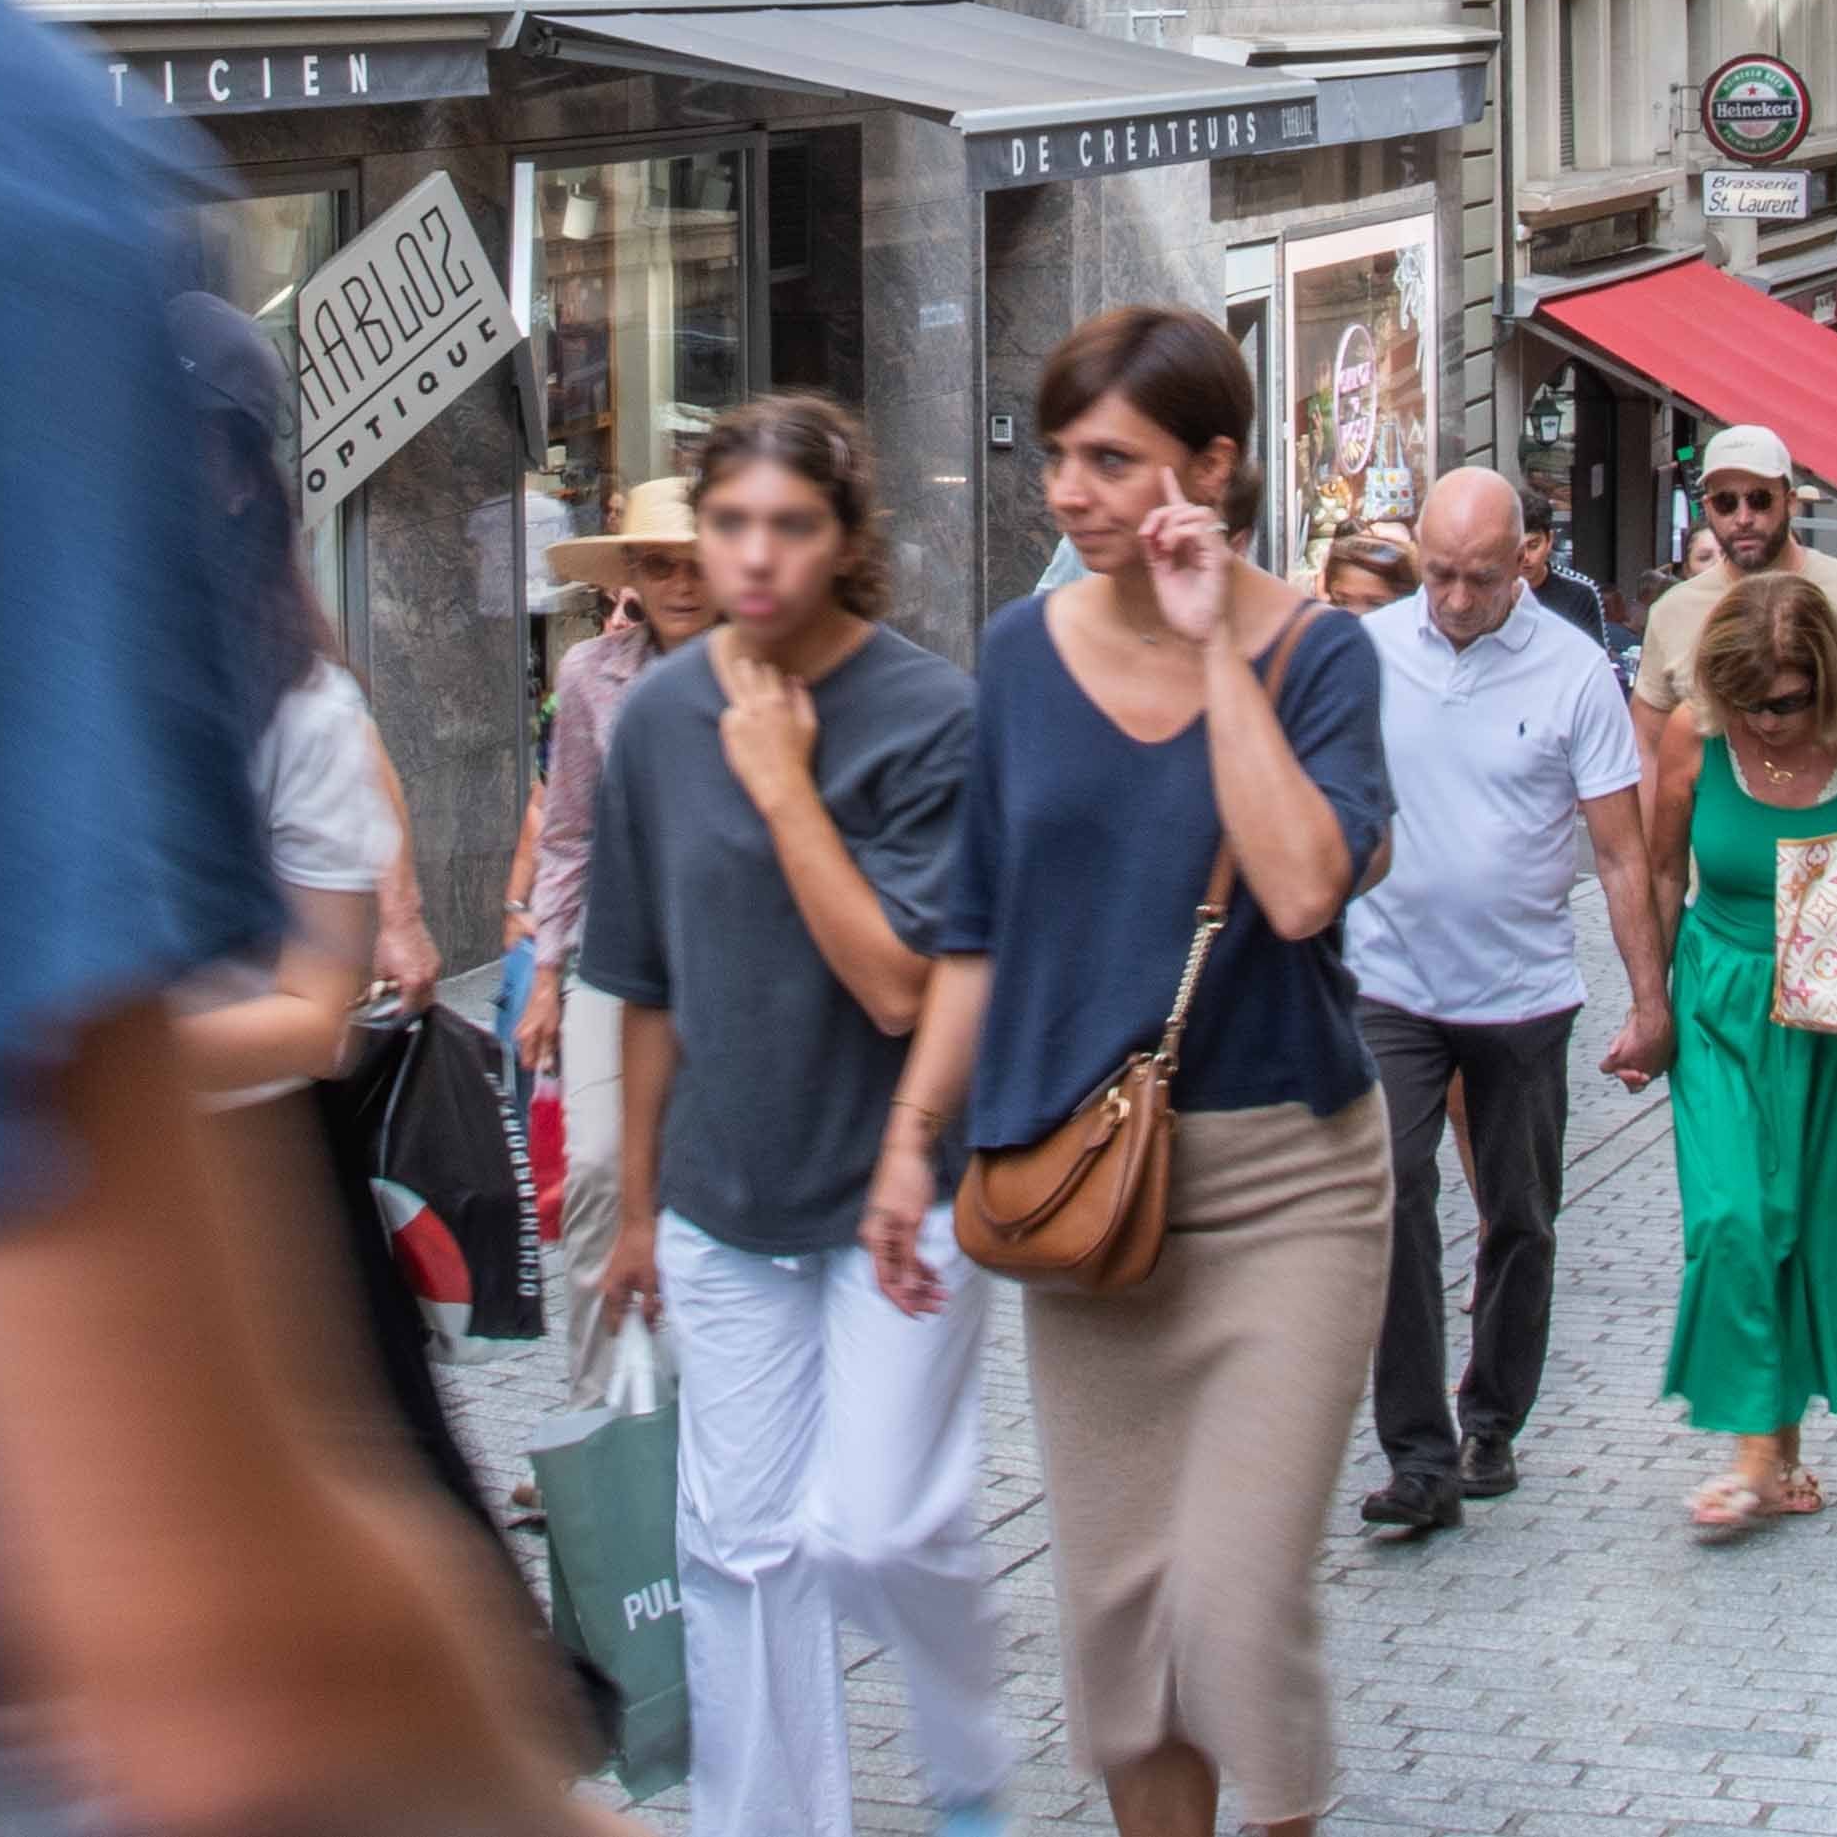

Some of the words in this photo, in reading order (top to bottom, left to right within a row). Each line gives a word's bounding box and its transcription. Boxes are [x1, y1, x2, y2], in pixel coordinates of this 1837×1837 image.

[1716, 101, 1792, 118] Heineken
[1011, 135, 1051, 176] DE
[1079, 111, 1258, 168] CRÉATEURS
[1712, 176, 1798, 190] Brasserie
[1709, 191, 1730, 212] St.
[1739, 193, 1799, 213] Laurent
[307, 315, 497, 493] OPTIQUE
